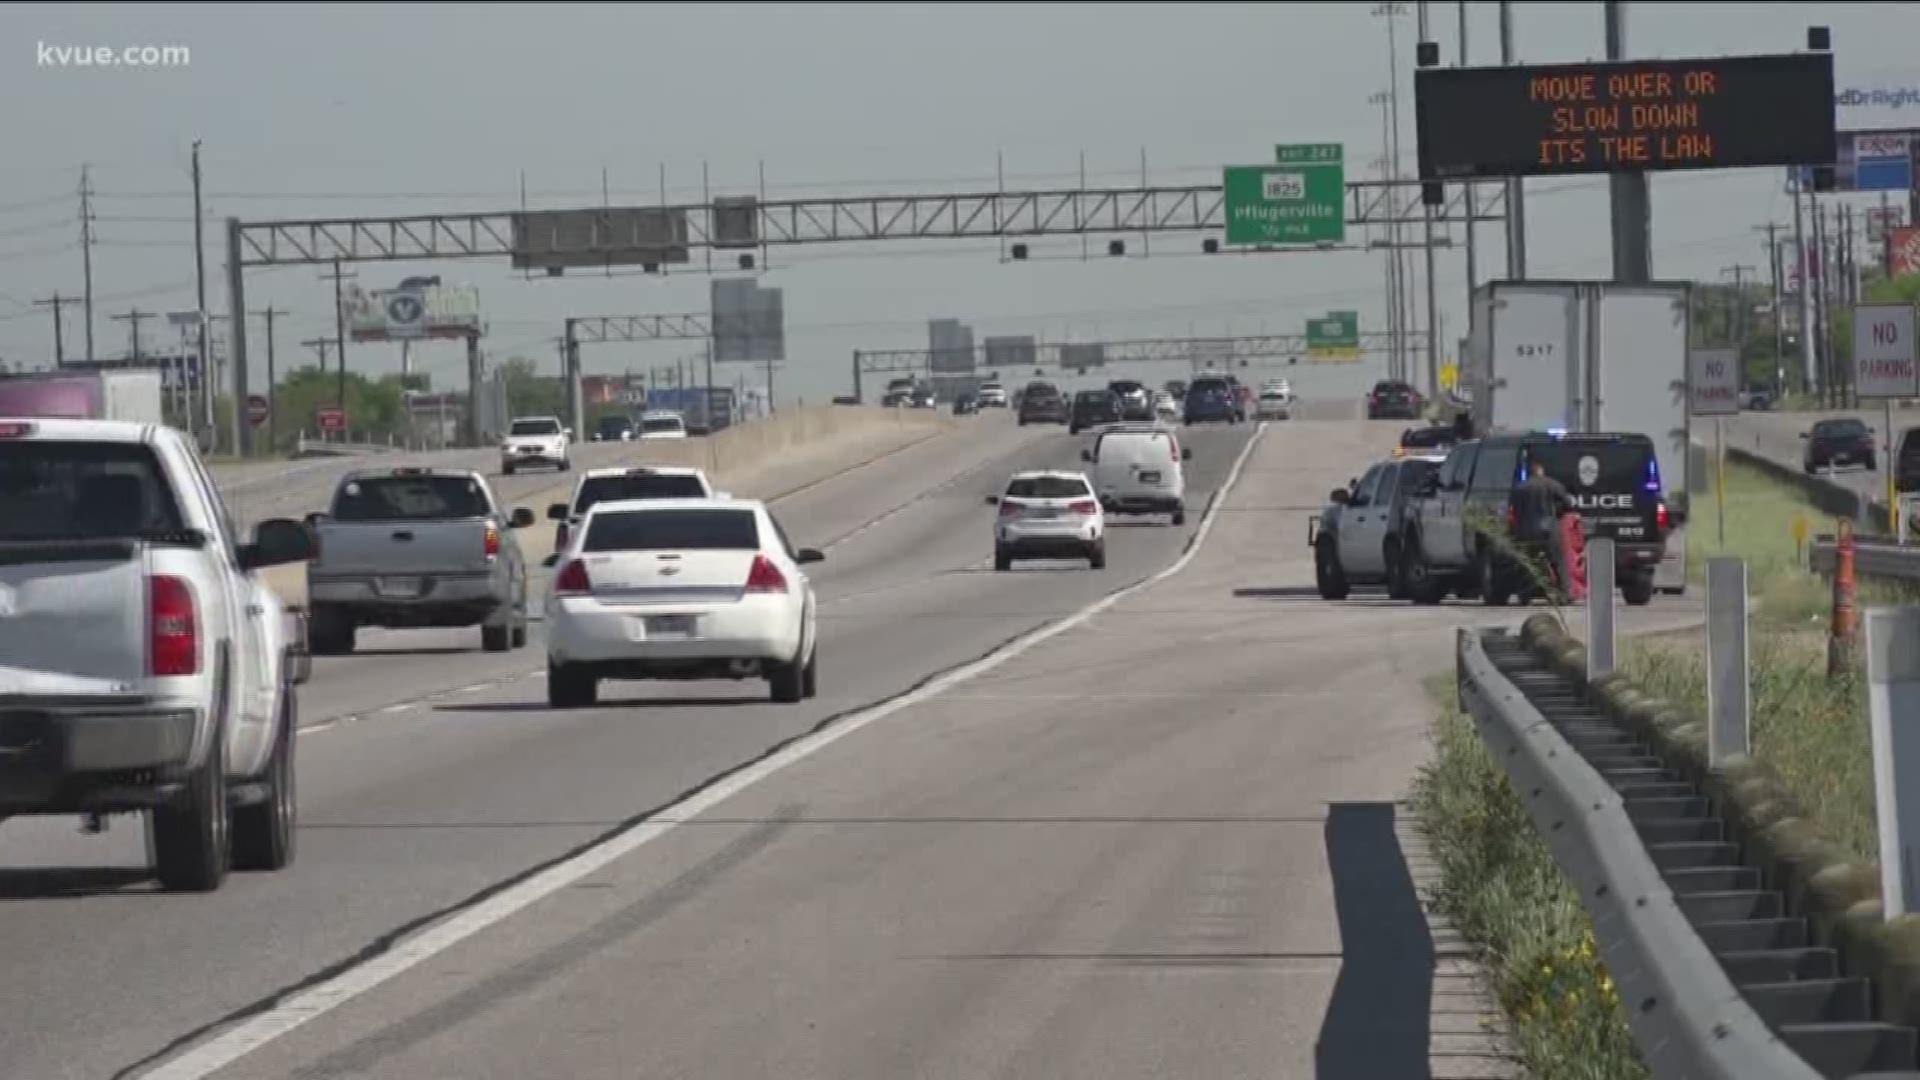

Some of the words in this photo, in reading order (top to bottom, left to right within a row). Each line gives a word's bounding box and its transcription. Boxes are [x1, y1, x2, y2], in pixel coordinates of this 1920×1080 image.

[1531, 75, 1596, 101] MOVE
[1608, 73, 1672, 98] OVER
[1684, 71, 1716, 95] OR
[1553, 105, 1620, 132] SLOW
[1631, 102, 1698, 129] DOWN
[1539, 137, 1586, 164] ITS
[1599, 135, 1650, 162] THE
[1661, 132, 1712, 159] LAW
[1266, 182, 1301, 197] 1825
[1234, 202, 1335, 222] Pflugerville
[1872, 322, 1898, 346] NO
[1705, 360, 1724, 379] NO
[1858, 358, 1914, 381] PARKING
